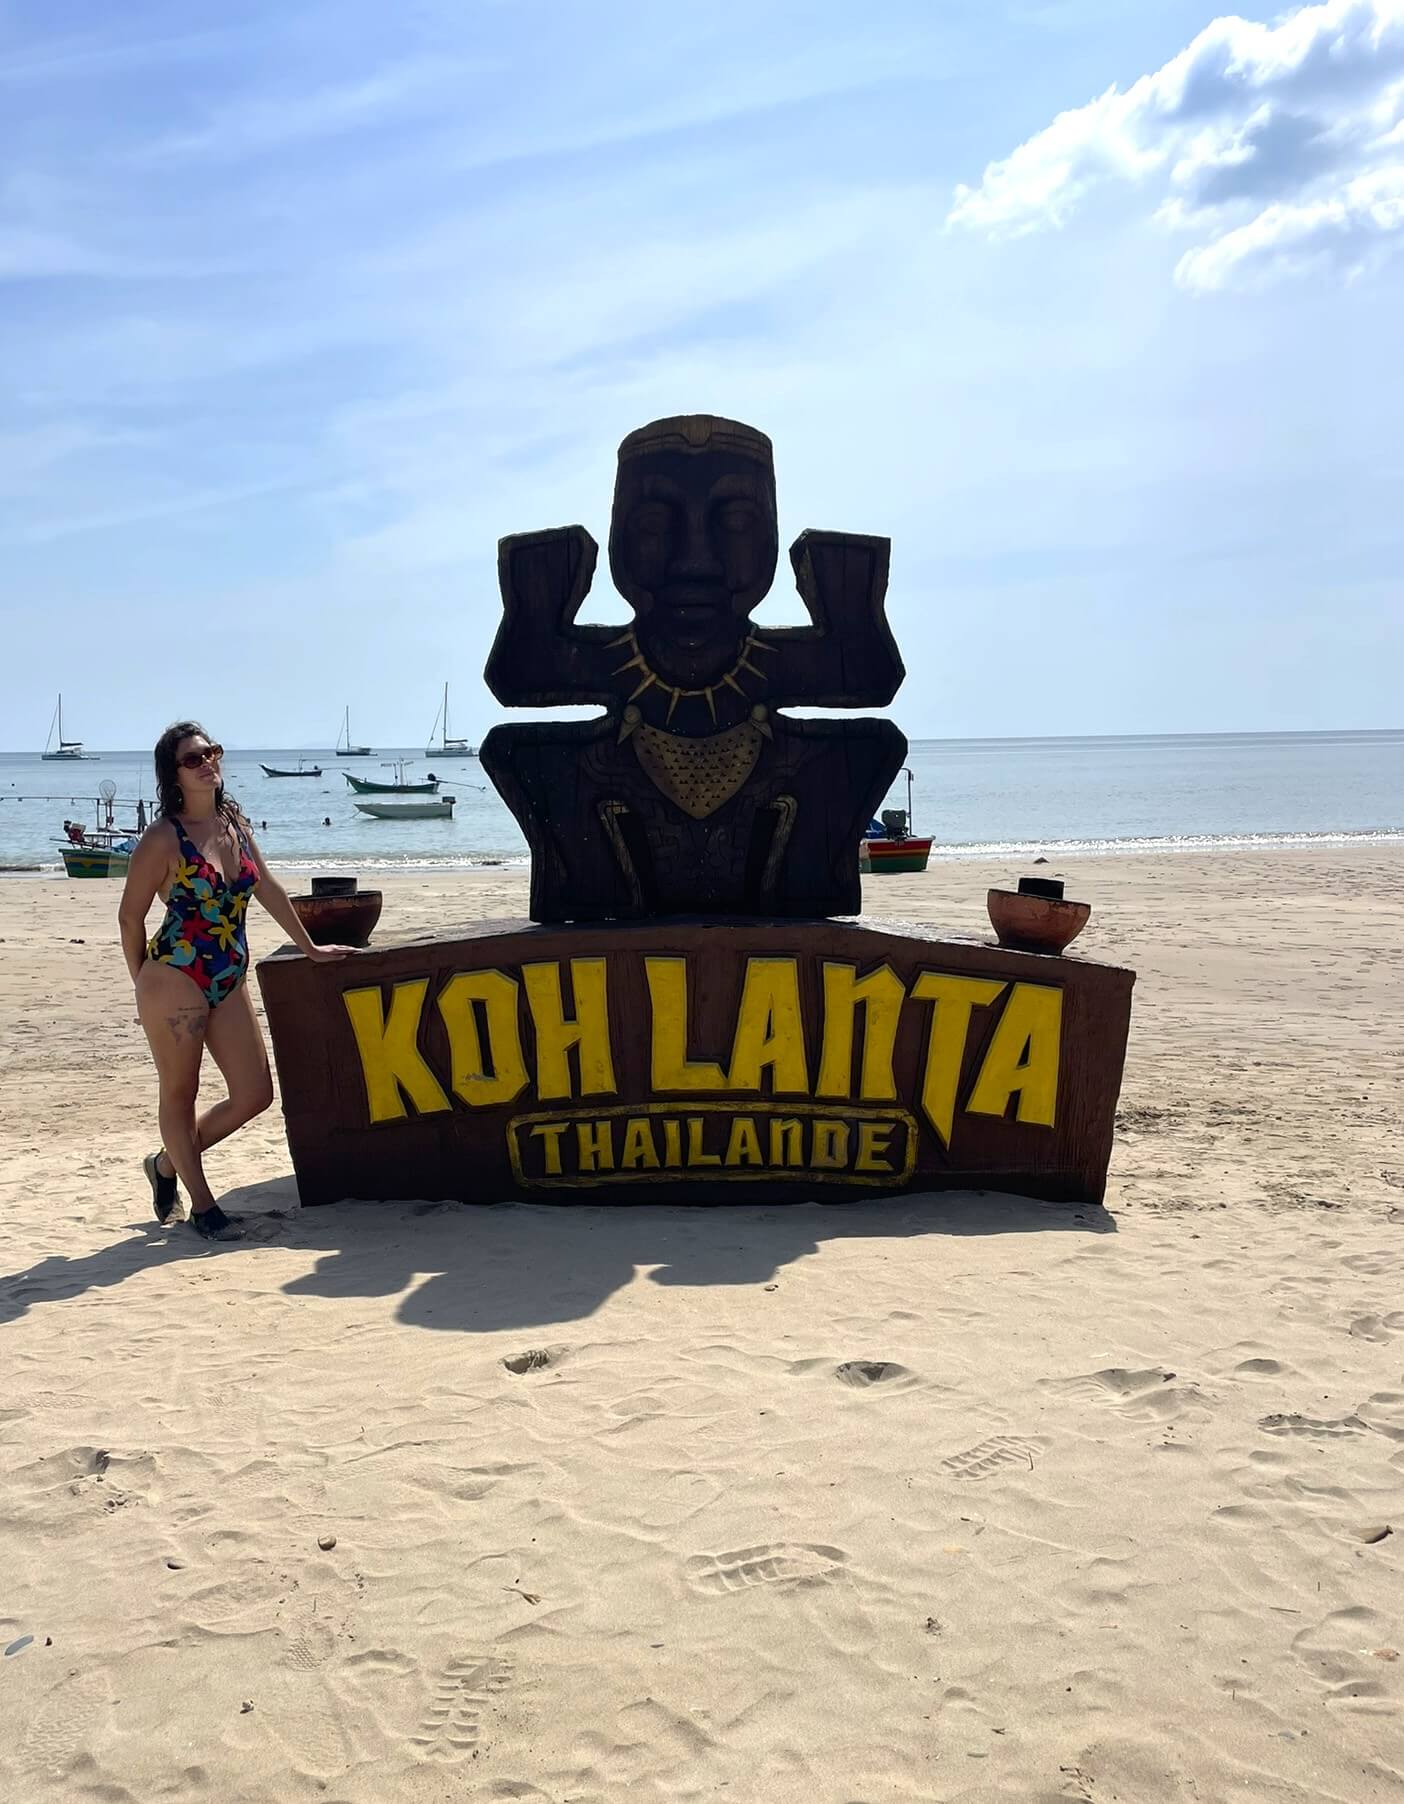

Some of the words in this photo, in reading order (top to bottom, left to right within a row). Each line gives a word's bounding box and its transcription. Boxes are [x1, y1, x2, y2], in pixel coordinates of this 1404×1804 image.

[343, 957, 618, 1124] KOH
[645, 956, 1065, 1150] LANTA
[530, 1117, 894, 1175] THAILANDE
